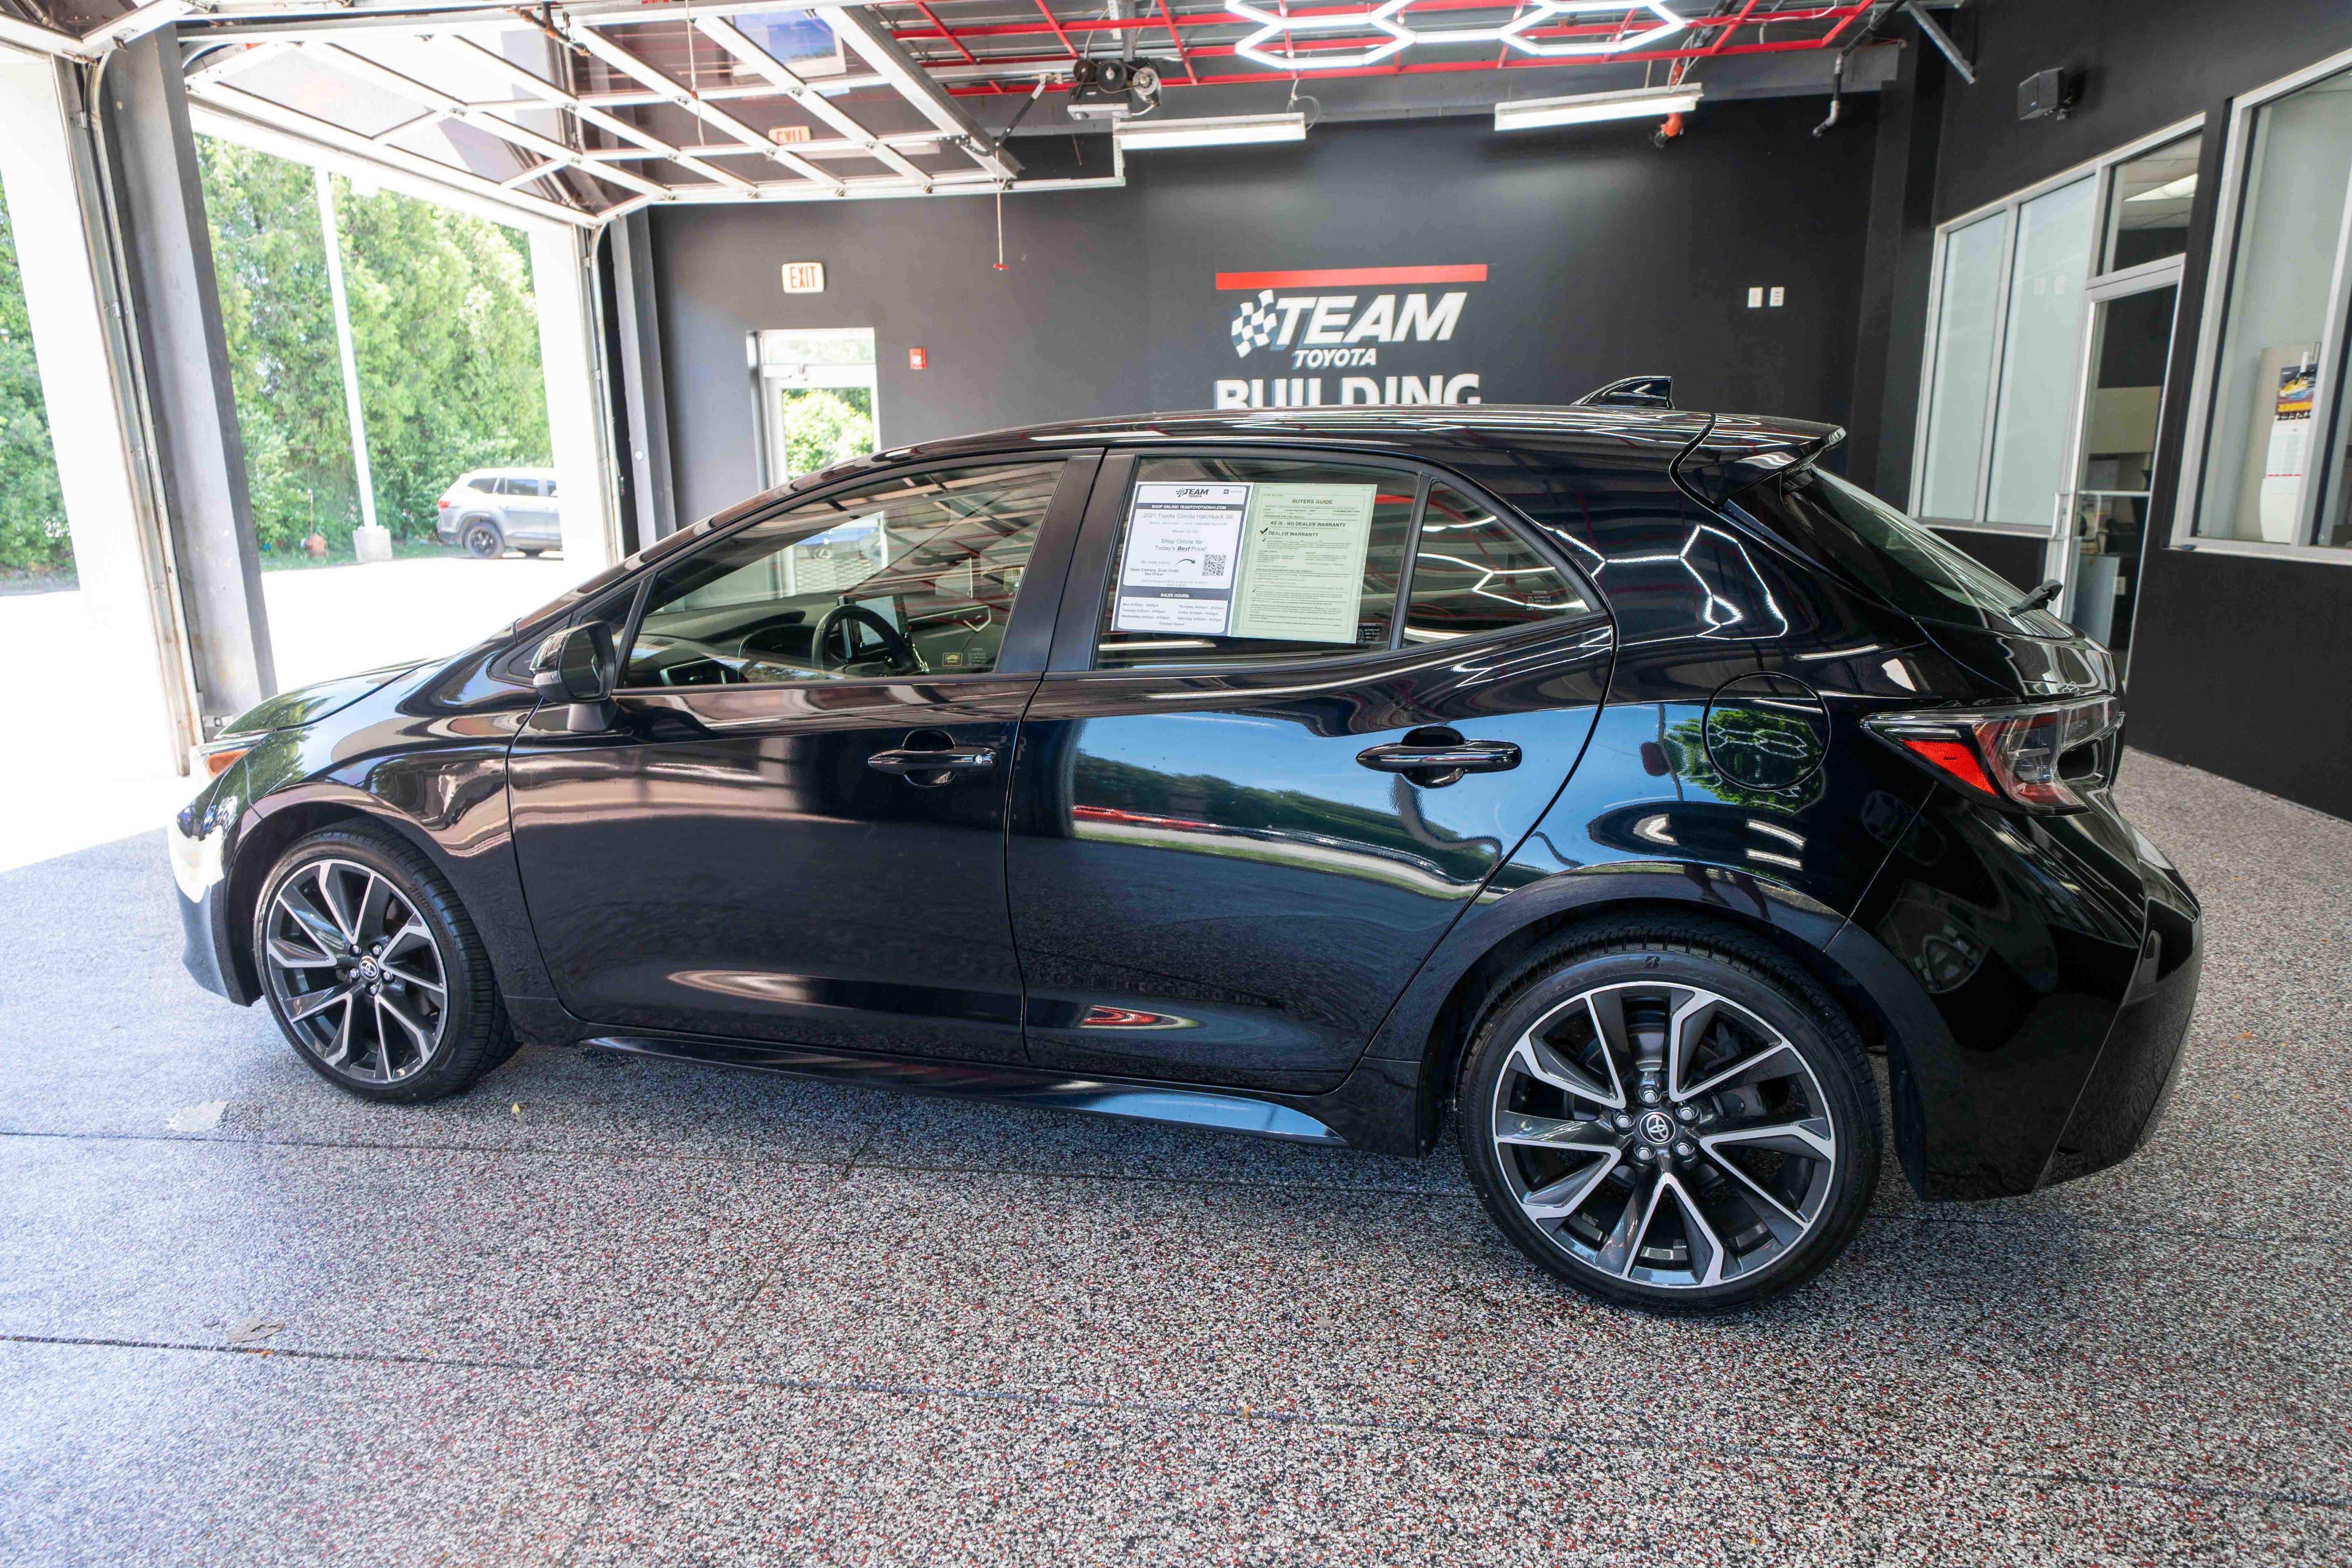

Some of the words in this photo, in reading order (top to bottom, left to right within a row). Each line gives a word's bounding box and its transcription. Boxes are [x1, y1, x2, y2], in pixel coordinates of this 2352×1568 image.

[790, 266, 815, 288] EXIT
[1272, 292, 1468, 347] TEAM
[1293, 348, 1376, 370] TOYOTA
[1214, 373, 1481, 409] BUILDING
